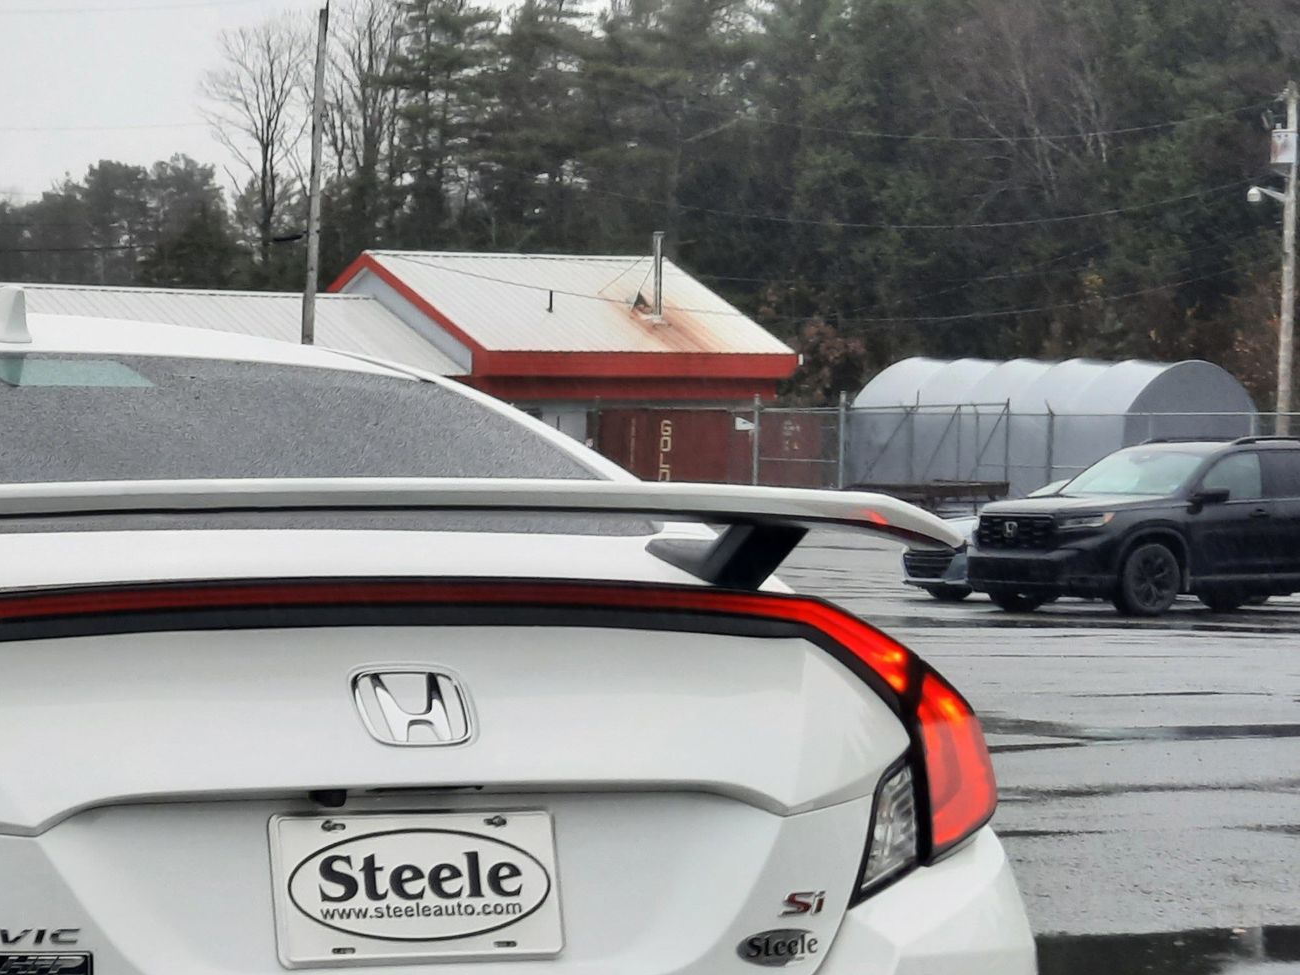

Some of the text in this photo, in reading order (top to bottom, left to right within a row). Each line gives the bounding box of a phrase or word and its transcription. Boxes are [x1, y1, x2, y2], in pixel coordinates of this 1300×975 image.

[318, 851, 523, 902] Steele
[320, 902, 523, 920] www.steeleauto.com
[777, 890, 826, 917] Si
[746, 933, 818, 958] Steele
